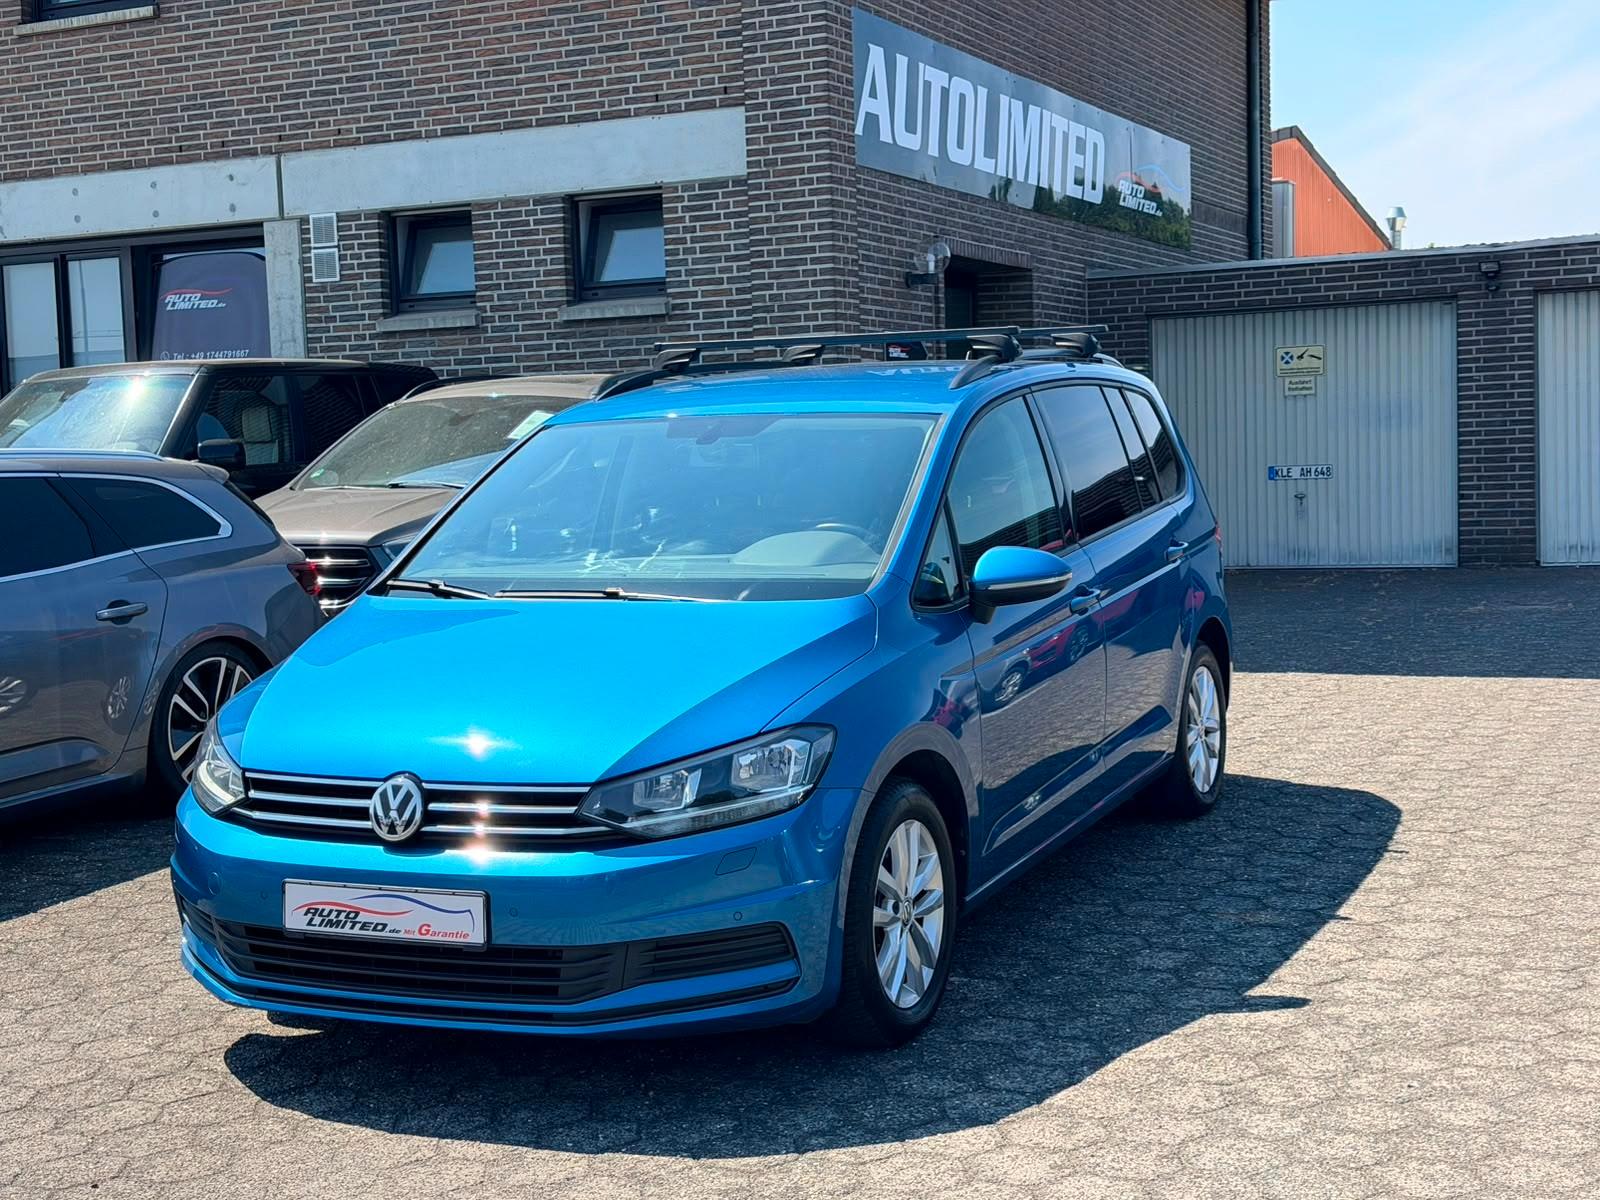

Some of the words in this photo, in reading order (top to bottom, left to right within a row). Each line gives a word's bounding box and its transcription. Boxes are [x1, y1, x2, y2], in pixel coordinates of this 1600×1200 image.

[854, 42, 1106, 205] AUTOLIMITED
[1118, 179, 1146, 199] AUTO
[165, 293, 202, 303] AUTO
[1274, 467, 1293, 478] KLE
[1299, 467, 1312, 478] AH
[1314, 466, 1332, 477] 648
[303, 907, 361, 921] AUTO
[403, 928, 416, 936] Mit
[417, 922, 470, 940] Garantie
